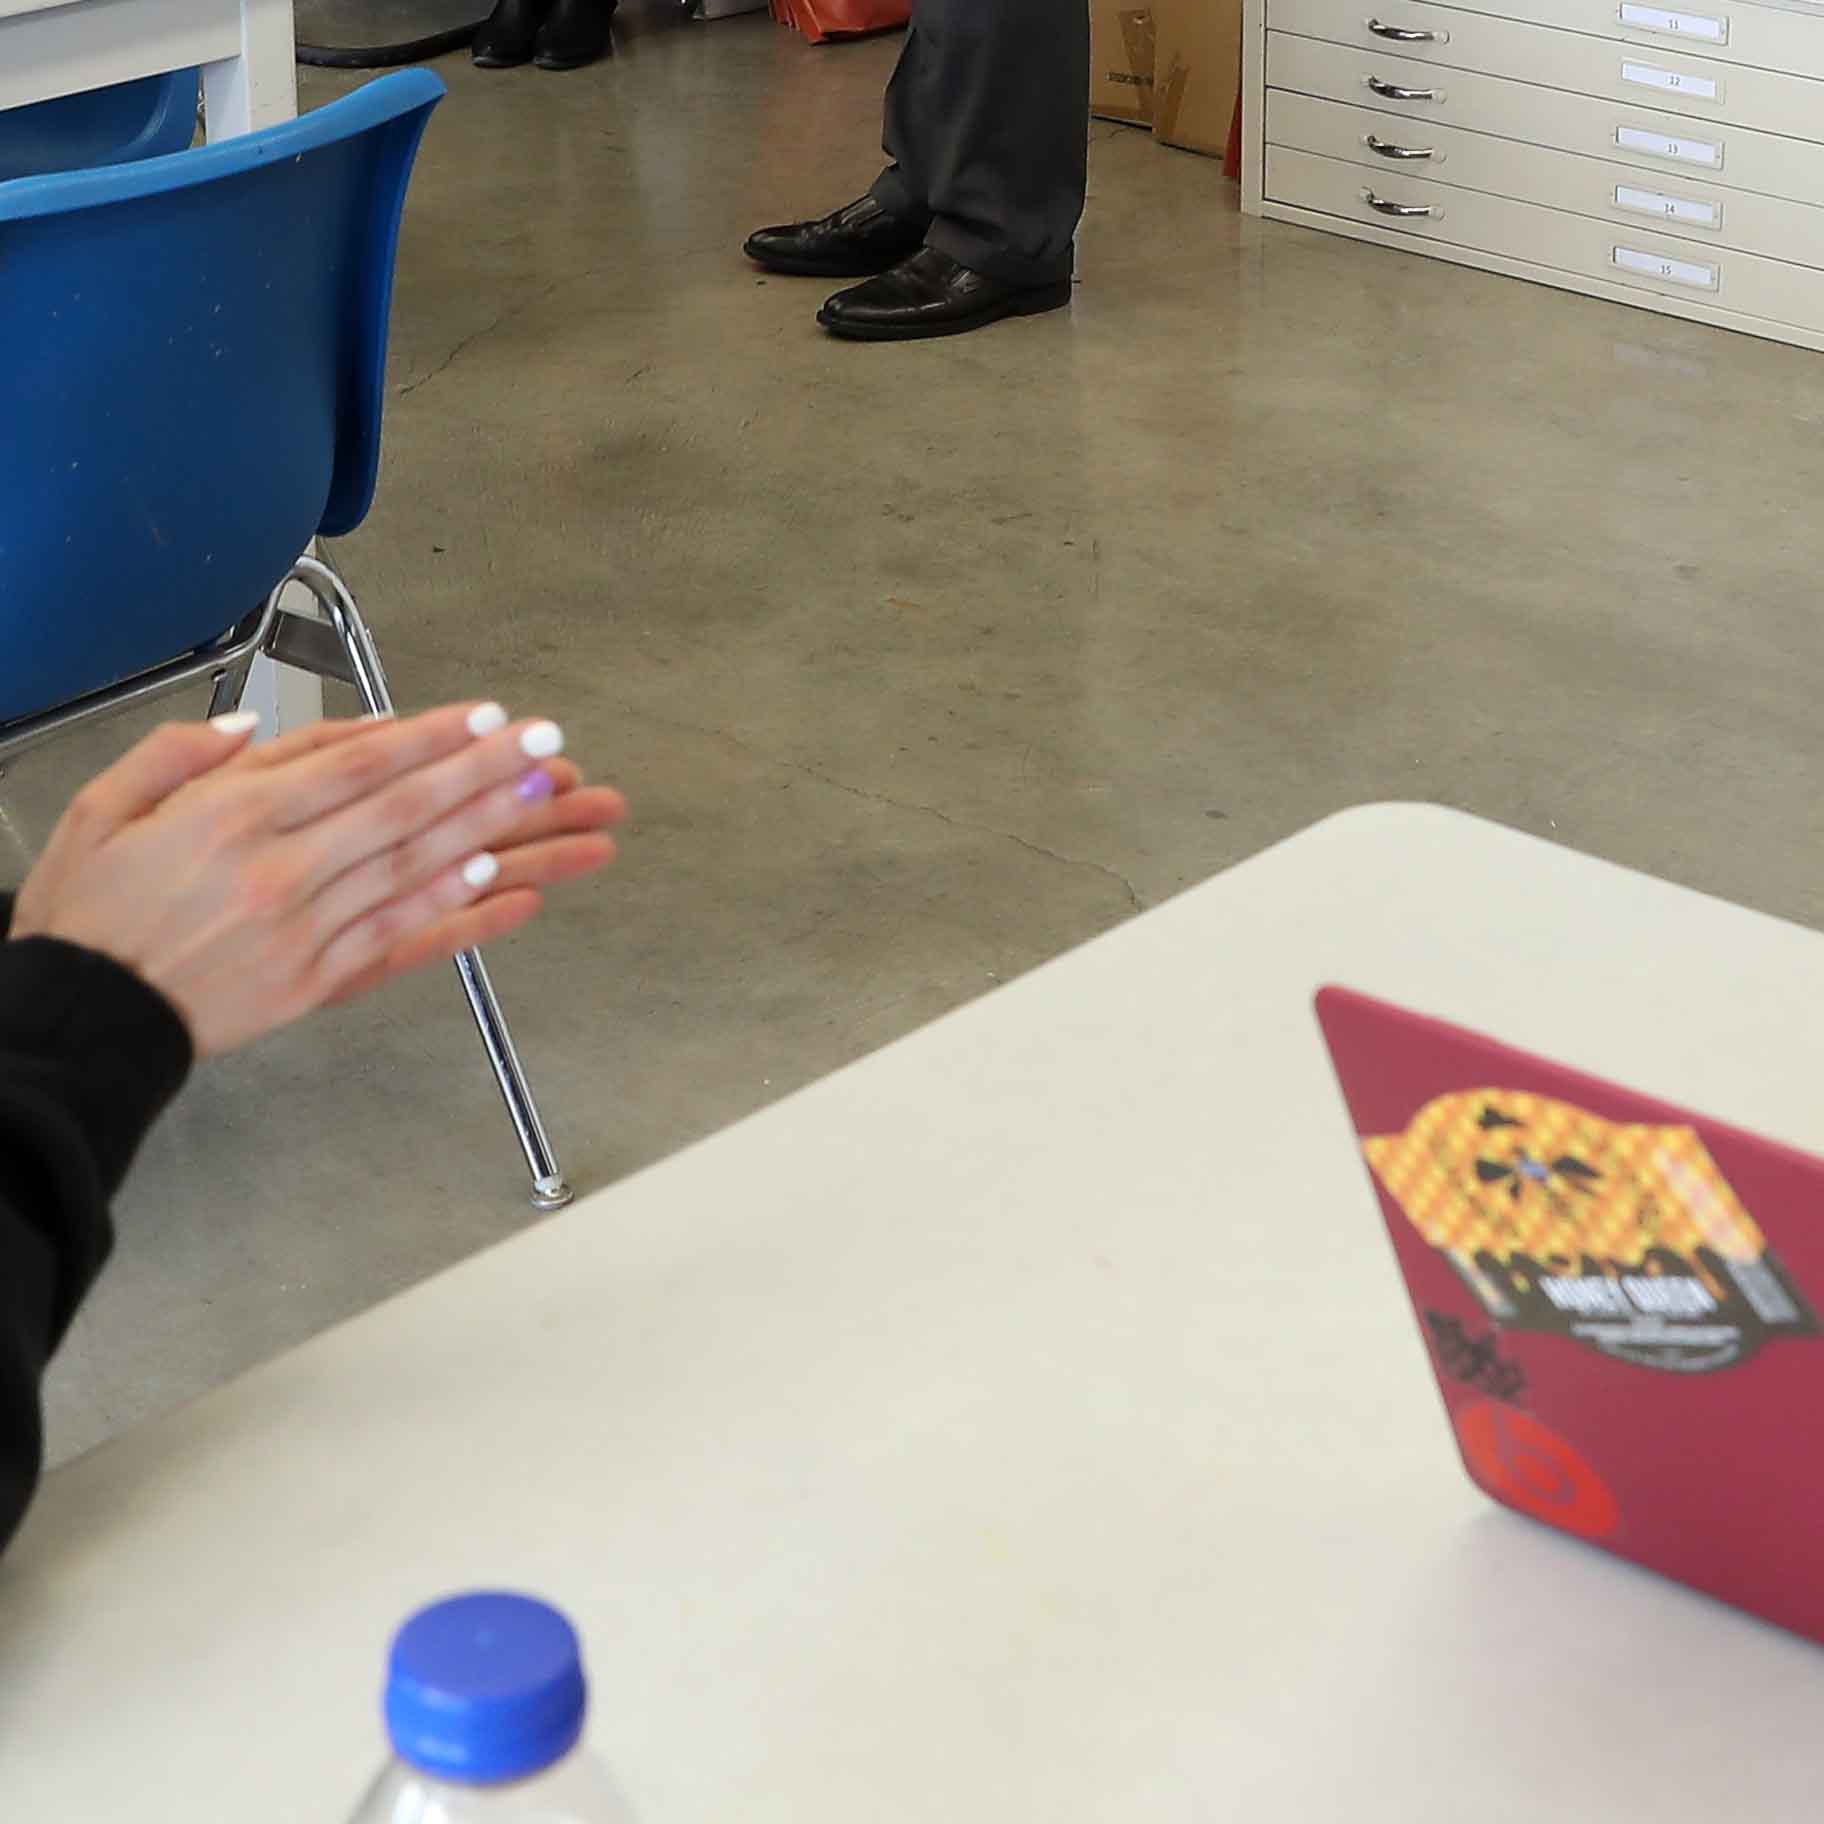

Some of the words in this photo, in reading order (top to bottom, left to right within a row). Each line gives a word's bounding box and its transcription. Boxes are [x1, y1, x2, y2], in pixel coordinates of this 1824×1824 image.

[1670, 20, 1678, 29] 11
[1671, 77, 1680, 85] 12
[1669, 145, 1678, 153] 13
[1666, 204, 1674, 213] 14
[1662, 266, 1671, 274] 15
